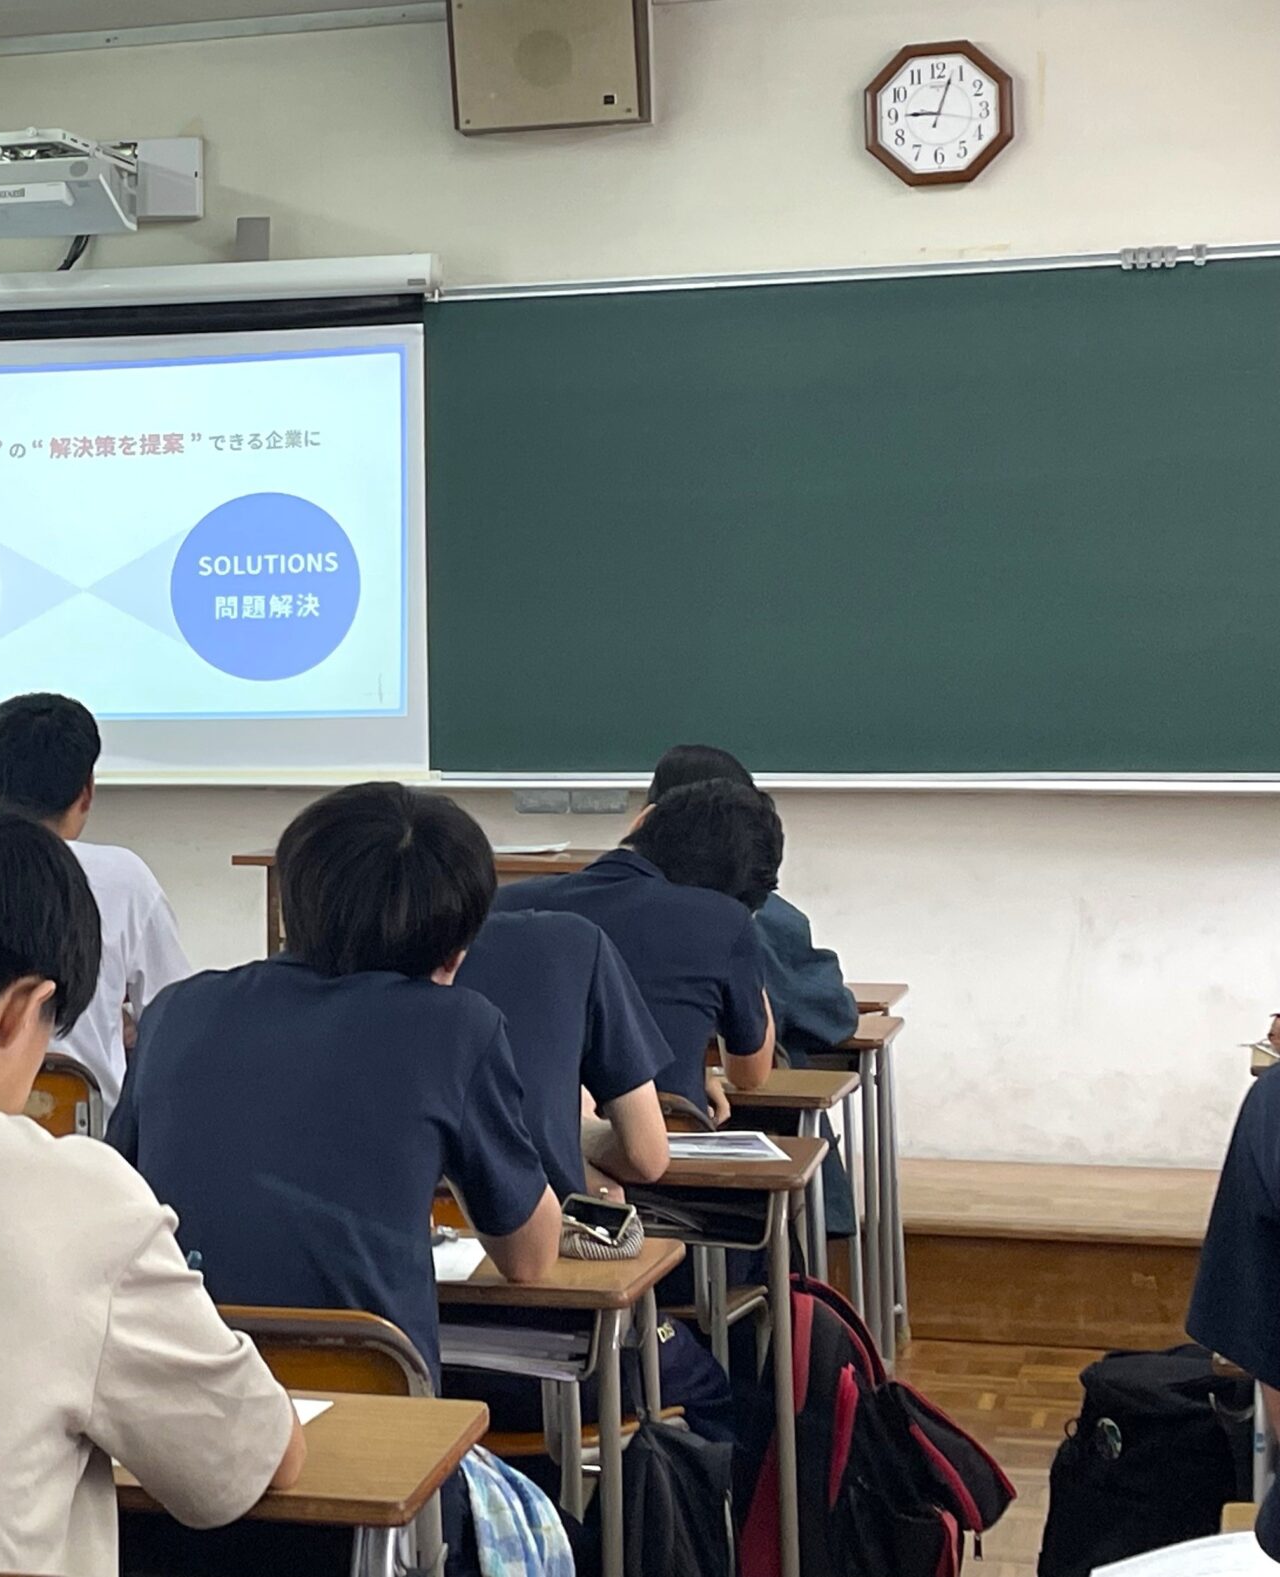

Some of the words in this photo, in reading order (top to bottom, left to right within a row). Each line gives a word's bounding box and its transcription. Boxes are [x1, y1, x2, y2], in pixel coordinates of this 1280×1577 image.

[910, 69, 922, 86] 11
[930, 62, 946, 79] 12
[959, 65, 964, 82] 1
[892, 87, 907, 103] 10
[972, 80, 984, 97] 2
[888, 108, 898, 125] 9
[979, 101, 990, 119] 3
[895, 129, 905, 146] 8
[973, 124, 983, 141] 4
[912, 144, 922, 161] 7
[934, 148, 945, 165] 6
[957, 141, 968, 159] 5
[198, 552, 339, 576] SOLUTIONS
[215, 592, 320, 620] 問題解決
